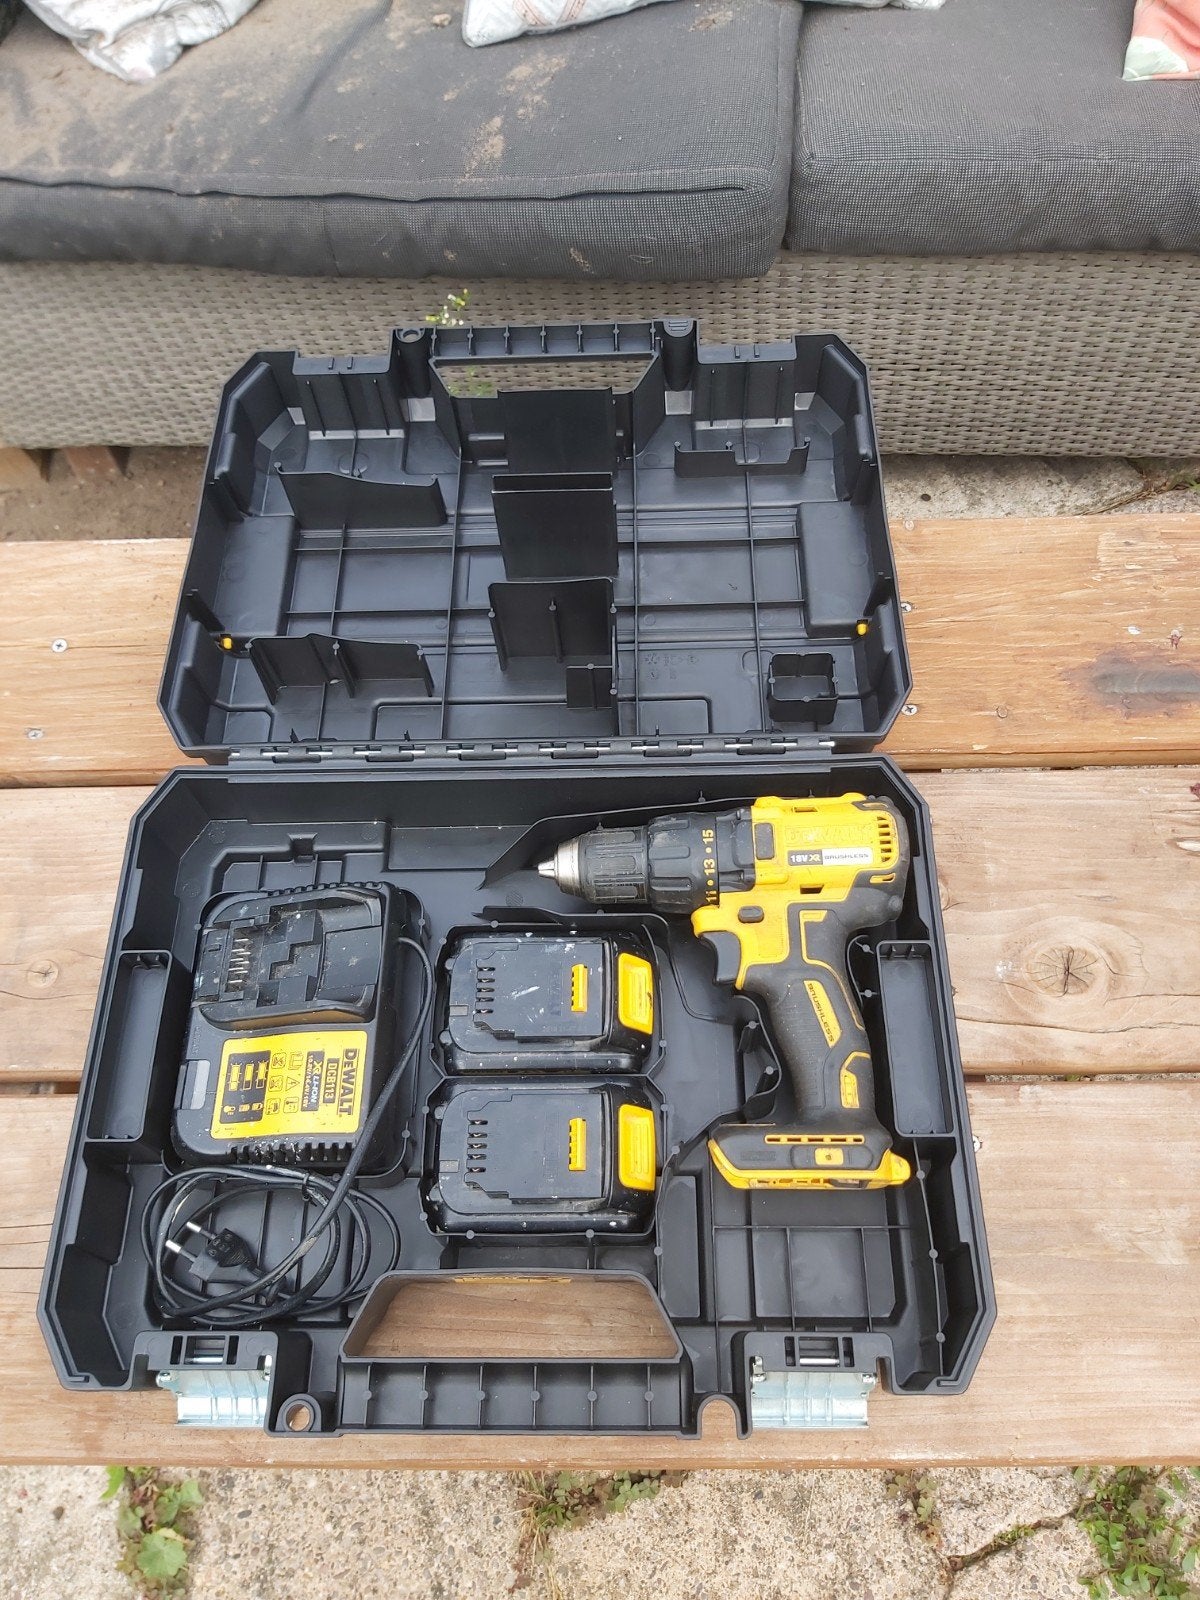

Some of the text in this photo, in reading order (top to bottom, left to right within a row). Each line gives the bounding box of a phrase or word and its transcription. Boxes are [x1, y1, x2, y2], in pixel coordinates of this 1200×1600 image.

[702, 829, 714, 844] 15
[703, 858, 716, 876] 13
[790, 854, 808, 863] 18V
[807, 983, 834, 1042] BRUSHLESS
[324, 1062, 338, 1099] DCB113
[339, 1049, 358, 1115] DEWALT
